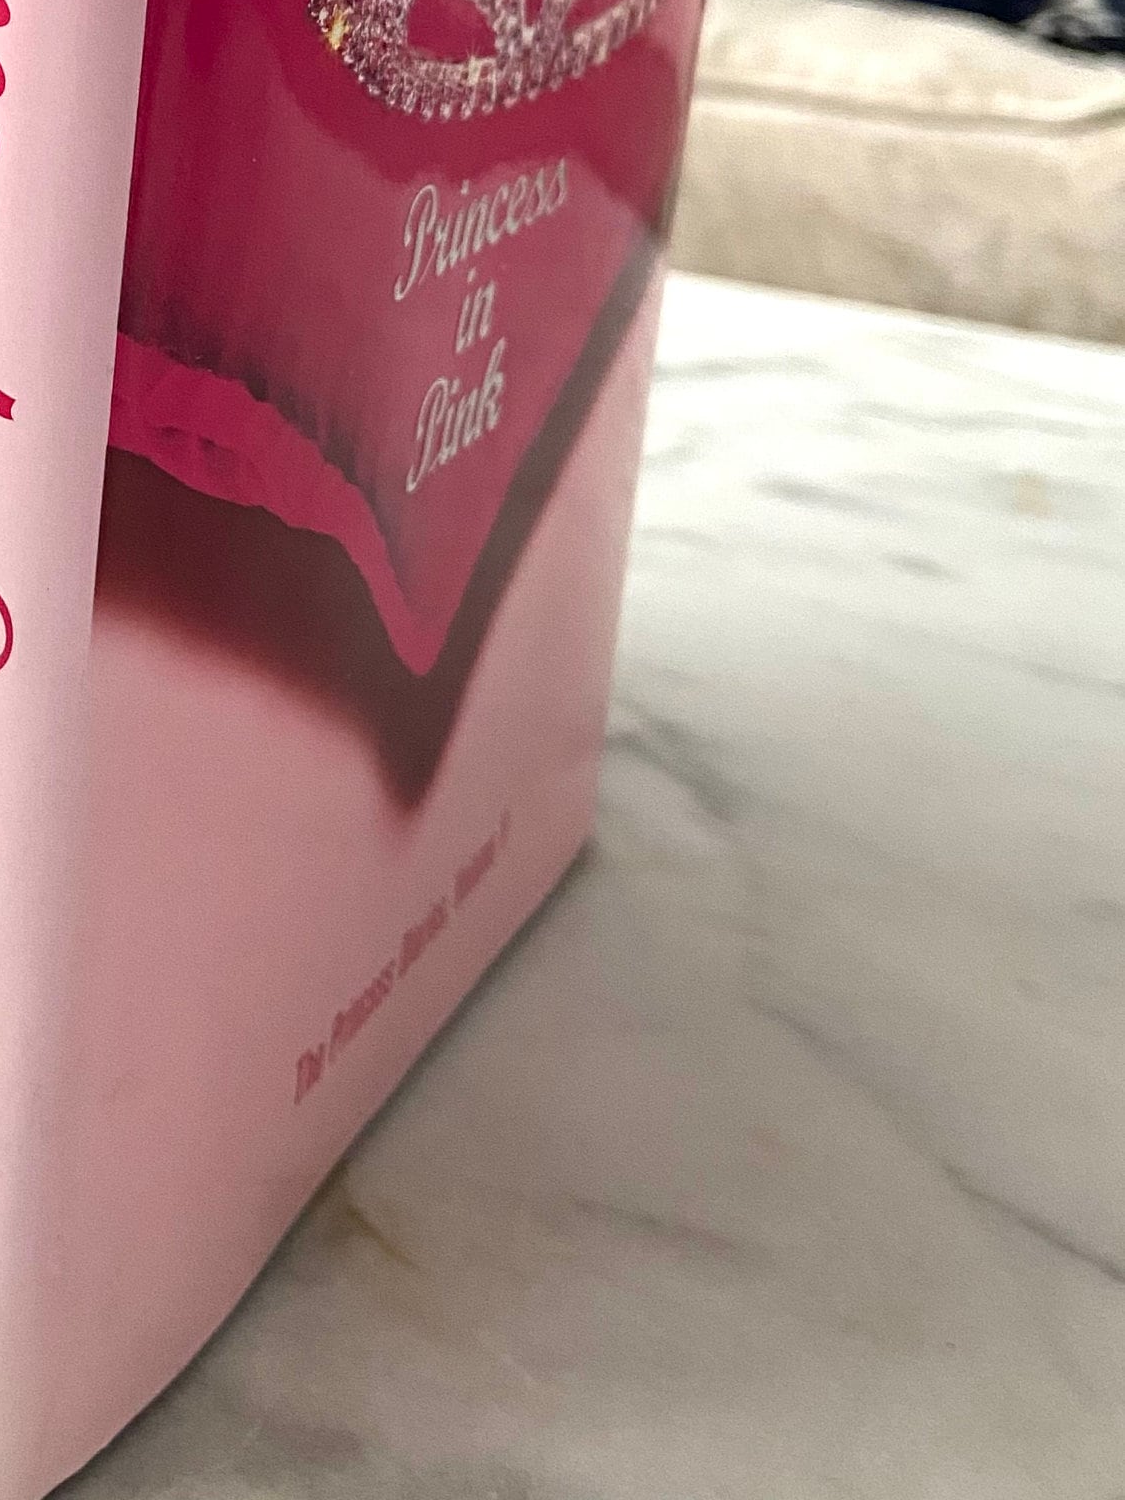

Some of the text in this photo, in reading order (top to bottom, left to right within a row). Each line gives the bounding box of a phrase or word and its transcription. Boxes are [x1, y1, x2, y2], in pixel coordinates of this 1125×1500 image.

[393, 157, 568, 301] Princess
[455, 265, 496, 354] in
[405, 336, 506, 493] Pink
